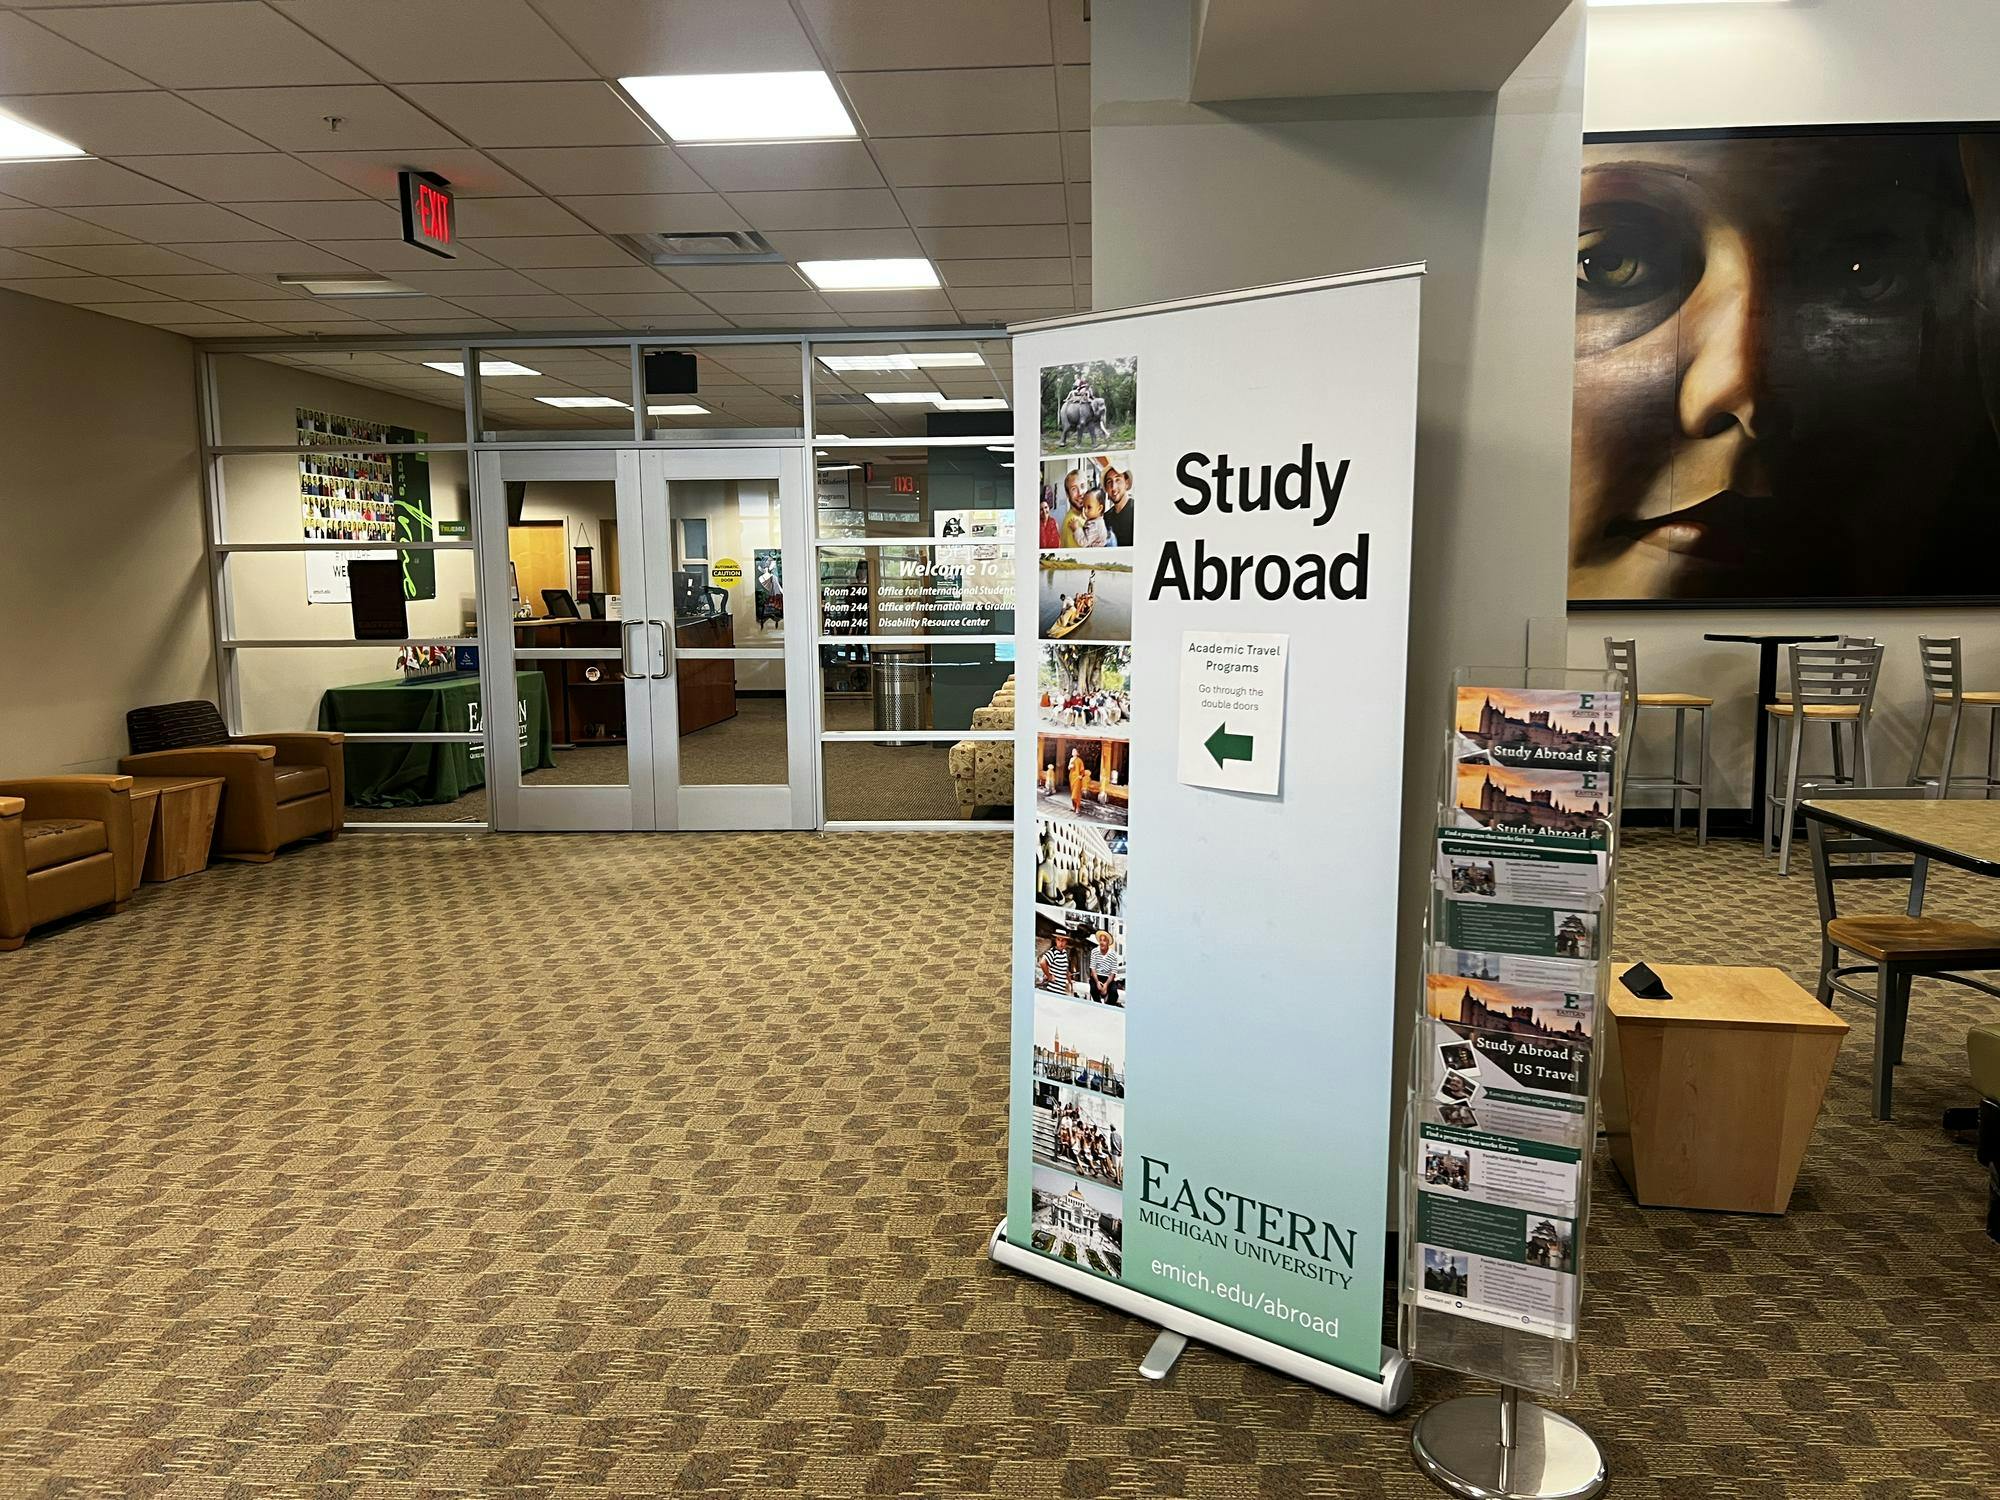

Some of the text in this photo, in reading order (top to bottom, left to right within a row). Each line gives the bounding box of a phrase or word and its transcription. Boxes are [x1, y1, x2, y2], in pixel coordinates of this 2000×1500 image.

[420, 185, 448, 244] EXIT
[1174, 443, 1351, 526] Study
[899, 560, 998, 577] Welcome To
[1149, 533, 1370, 600] Abroad
[824, 587, 868, 596] Room 240
[878, 586, 904, 596] Office
[905, 586, 919, 596] for
[920, 587, 977, 596] International
[824, 603, 868, 612] Room 244
[878, 602, 904, 612] Office
[905, 602, 916, 612] of
[916, 603, 975, 612] International
[825, 619, 868, 628] Room 246
[878, 618, 990, 629] Disability Resource Center
[1188, 642, 1281, 656] Academic Travel
[1206, 660, 1259, 674] Programs
[1198, 684, 1264, 698] Go through the
[1201, 699, 1259, 711] double doors
[1579, 694, 1595, 710] E
[1494, 745, 1597, 762] Study Abroad &
[1582, 773, 1597, 790] E
[1496, 823, 1535, 834] Study
[1537, 826, 1587, 839] Abroad
[1563, 993, 1579, 1009] E
[1477, 1037, 1584, 1063] Study Abroad &
[1513, 1062, 1579, 1082] US Travel
[1443, 1134, 1467, 1143] program
[1140, 1155, 1358, 1269] EASTERN
[1139, 1207, 1353, 1291] MICHIGAN UNIVERSITY
[1151, 1259, 1339, 1338] emich.edu/abroad
